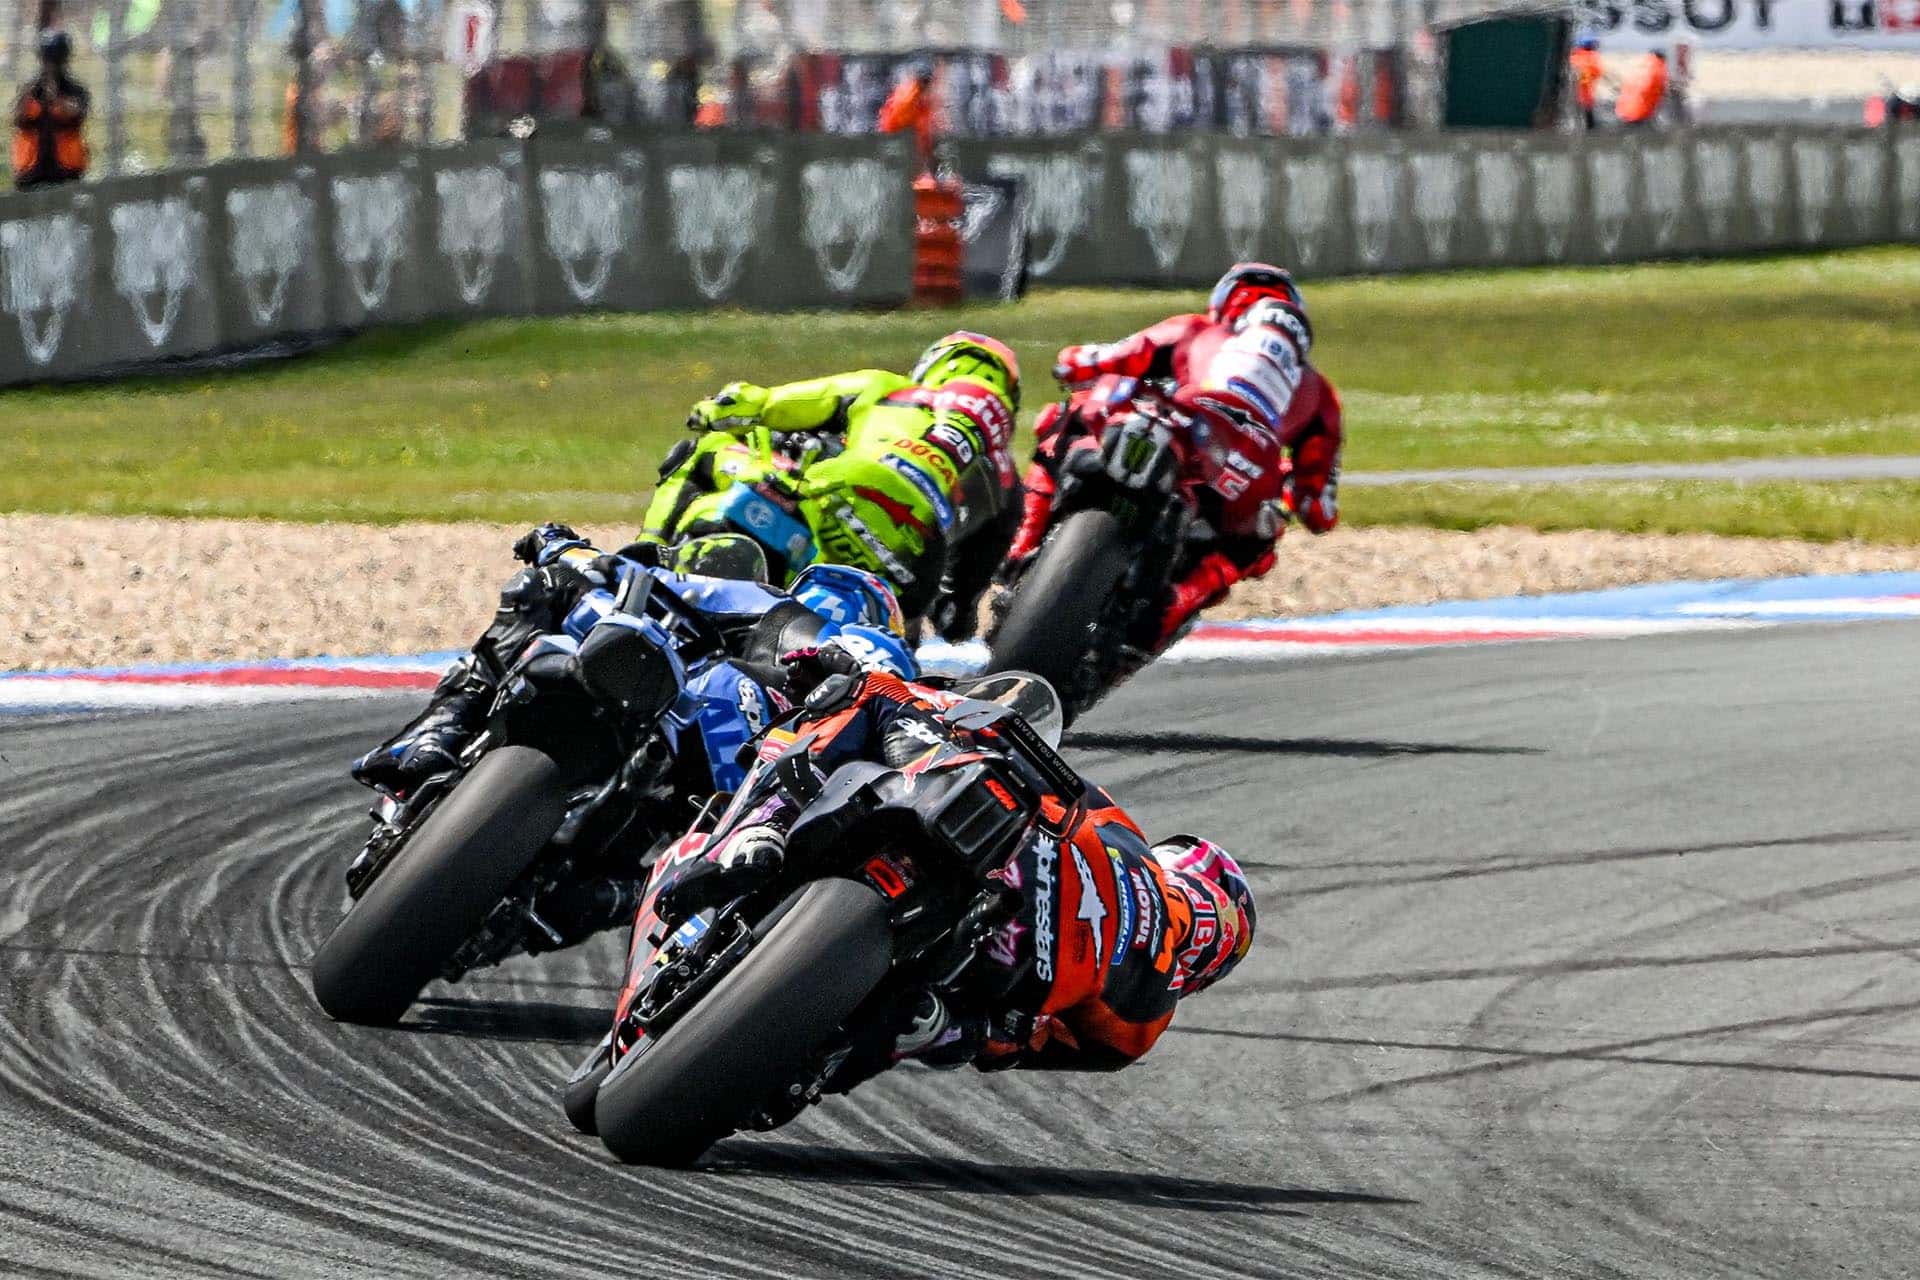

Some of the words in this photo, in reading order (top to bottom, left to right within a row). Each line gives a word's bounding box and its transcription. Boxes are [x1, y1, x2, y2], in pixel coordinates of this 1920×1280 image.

[1013, 717, 1036, 741] GIVES
[1037, 741, 1053, 758] YOU
[1052, 757, 1078, 787] WINGS
[1032, 832, 1057, 982] alpinestars
[1117, 879, 1130, 954] MICHELIN
[1130, 871, 1150, 945] MOTUL
